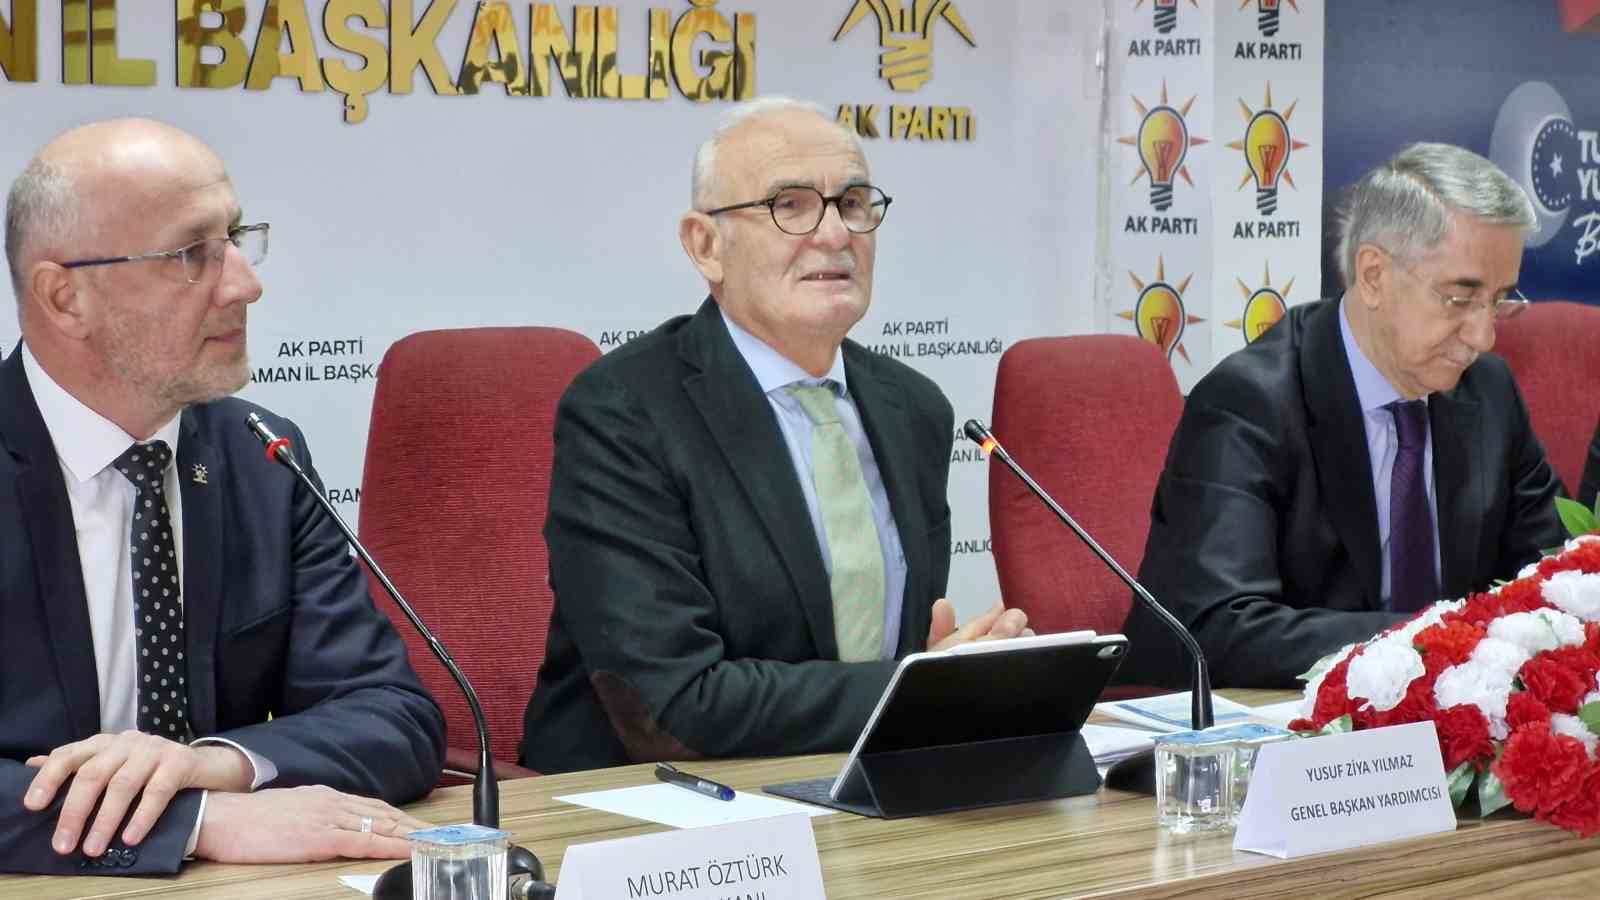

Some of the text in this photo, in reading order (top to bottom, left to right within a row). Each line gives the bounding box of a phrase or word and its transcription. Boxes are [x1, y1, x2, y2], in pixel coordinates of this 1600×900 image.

[1127, 40, 1150, 56] AK
[1234, 42, 1256, 59] AK
[174, 0, 757, 124] BAŞKANLIĞI
[837, 104, 880, 138] AK
[1124, 216, 1148, 233] AK
[1233, 222, 1255, 239] AK
[882, 317, 949, 336] AK PARTİ
[278, 336, 363, 357] AK PARTİ
[600, 330, 622, 345] AK
[917, 337, 1003, 359] BAŞKANLIĞI
[305, 362, 320, 381] İL
[324, 363, 376, 384] BAŞK
[1306, 754, 1414, 782] YUSUF ZİYA YILMAZ
[1290, 784, 1442, 822] GENEL BAŞKAN YARDIMCISI
[627, 854, 788, 899] MURAT ÖZTÜRK
